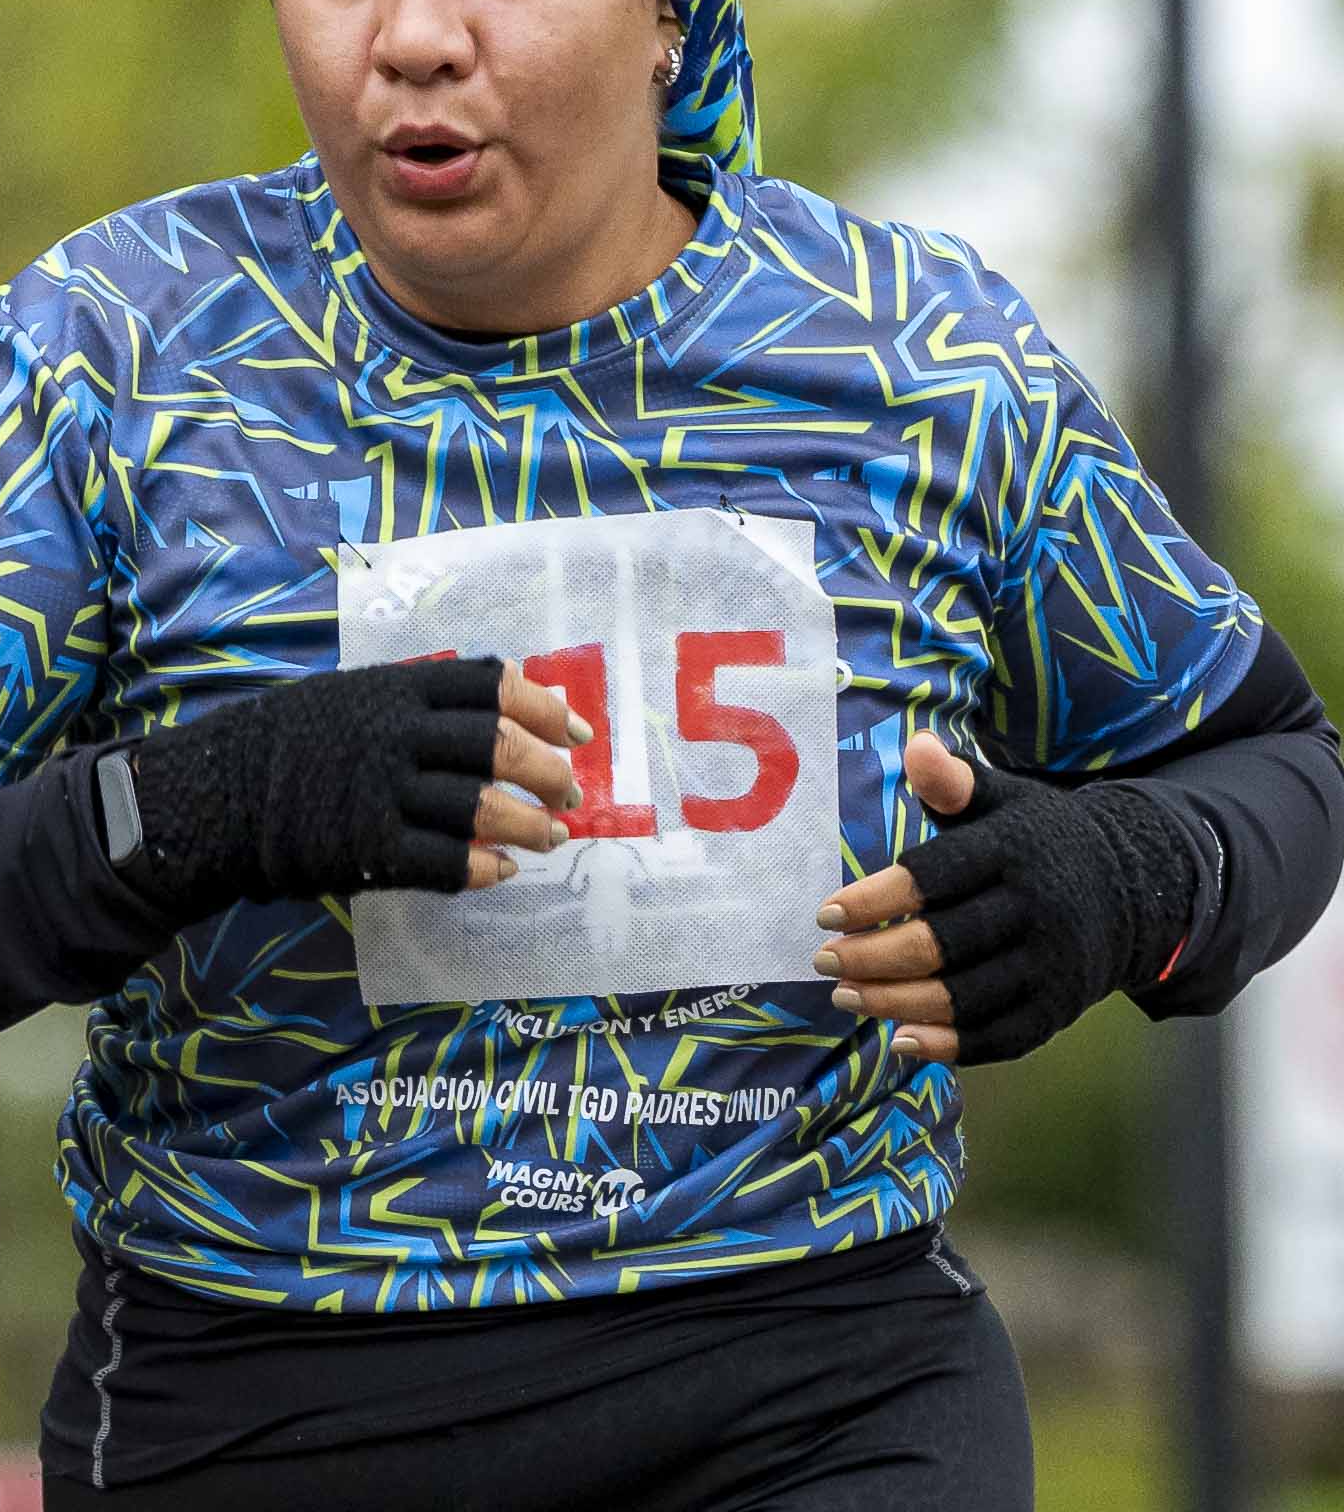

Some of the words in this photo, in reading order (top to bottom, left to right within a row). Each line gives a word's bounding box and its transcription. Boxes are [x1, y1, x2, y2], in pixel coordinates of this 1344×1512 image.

[389, 629, 800, 845] 15
[640, 1014, 657, 1033] Y
[336, 1069, 493, 1111] ASOCIACIÓN
[495, 1079, 560, 1116] CIVIL
[567, 1084, 618, 1123] TGD
[623, 1091, 722, 1126] PADRES
[487, 1160, 594, 1193] MAGNY
[500, 1186, 587, 1214] COURS
